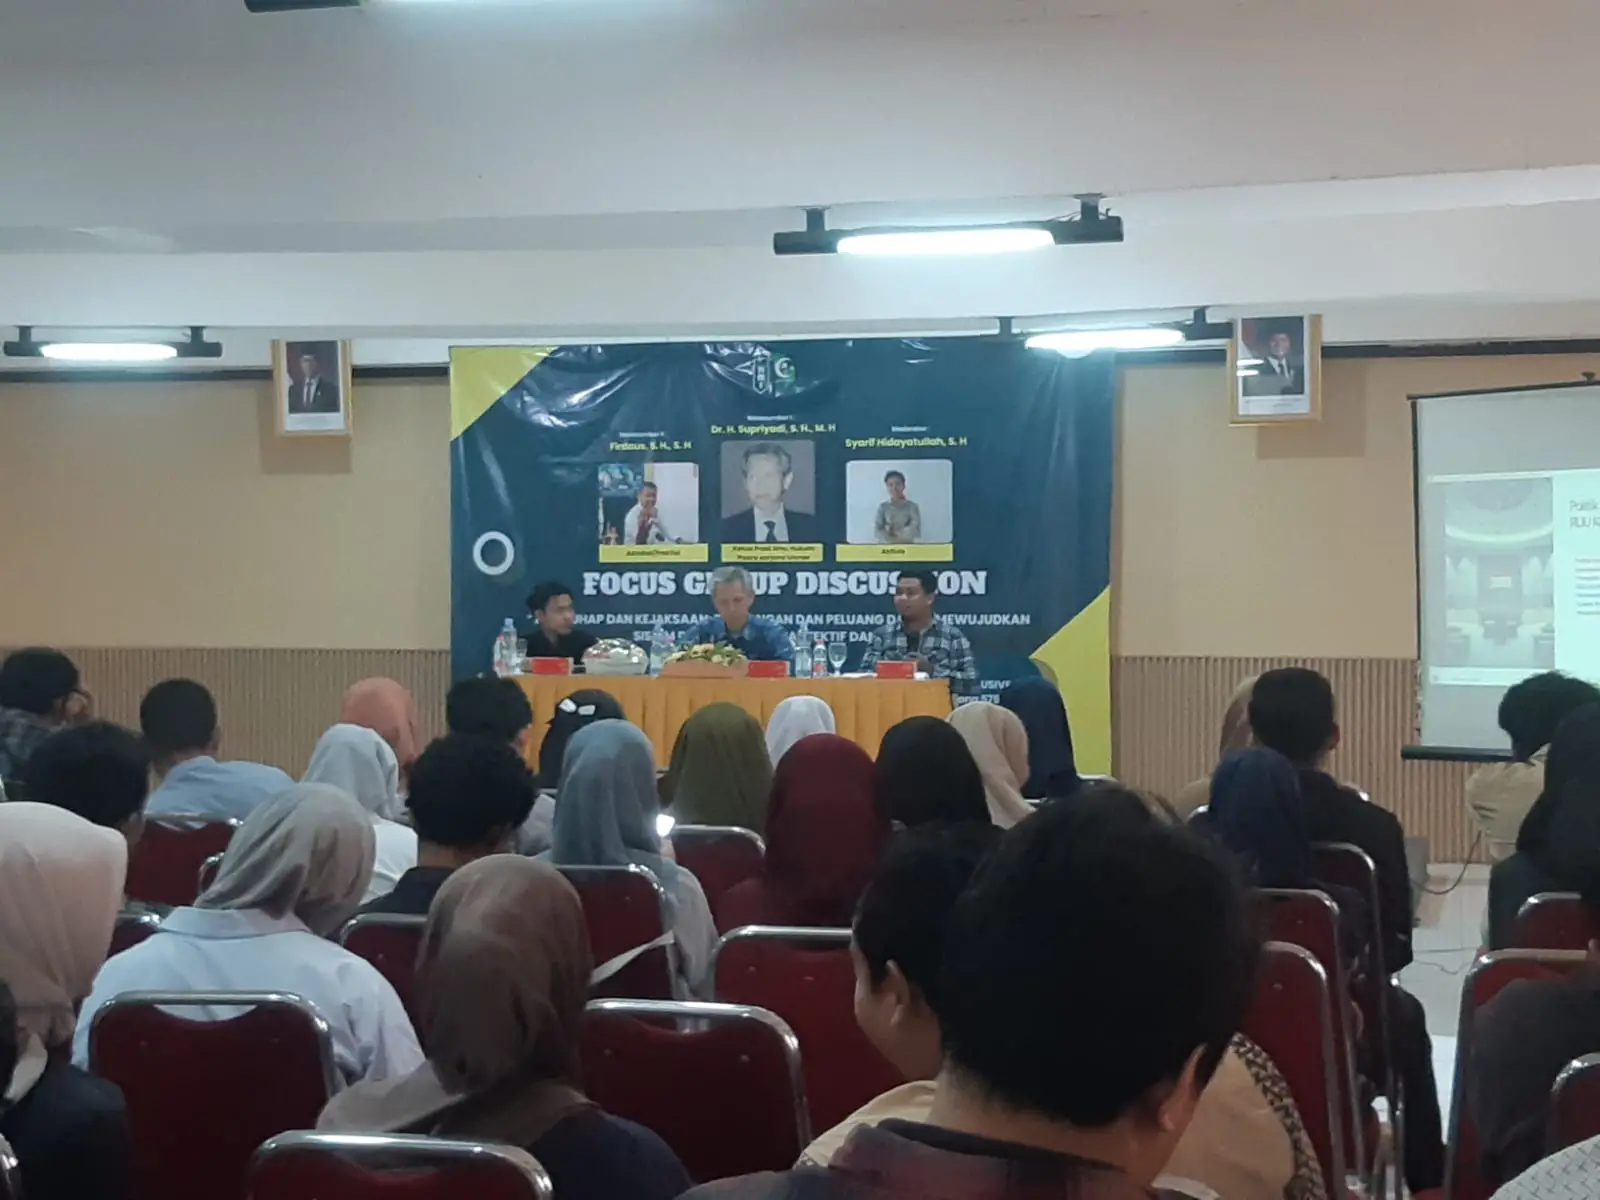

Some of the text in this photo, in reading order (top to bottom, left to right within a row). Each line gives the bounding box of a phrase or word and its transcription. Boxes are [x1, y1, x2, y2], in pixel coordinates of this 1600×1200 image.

[583, 572, 676, 596] FOCUS
[683, 572, 788, 596] GUP
[606, 614, 633, 625] DAN
[795, 614, 824, 625] DAN
[826, 614, 885, 625] PELUANG
